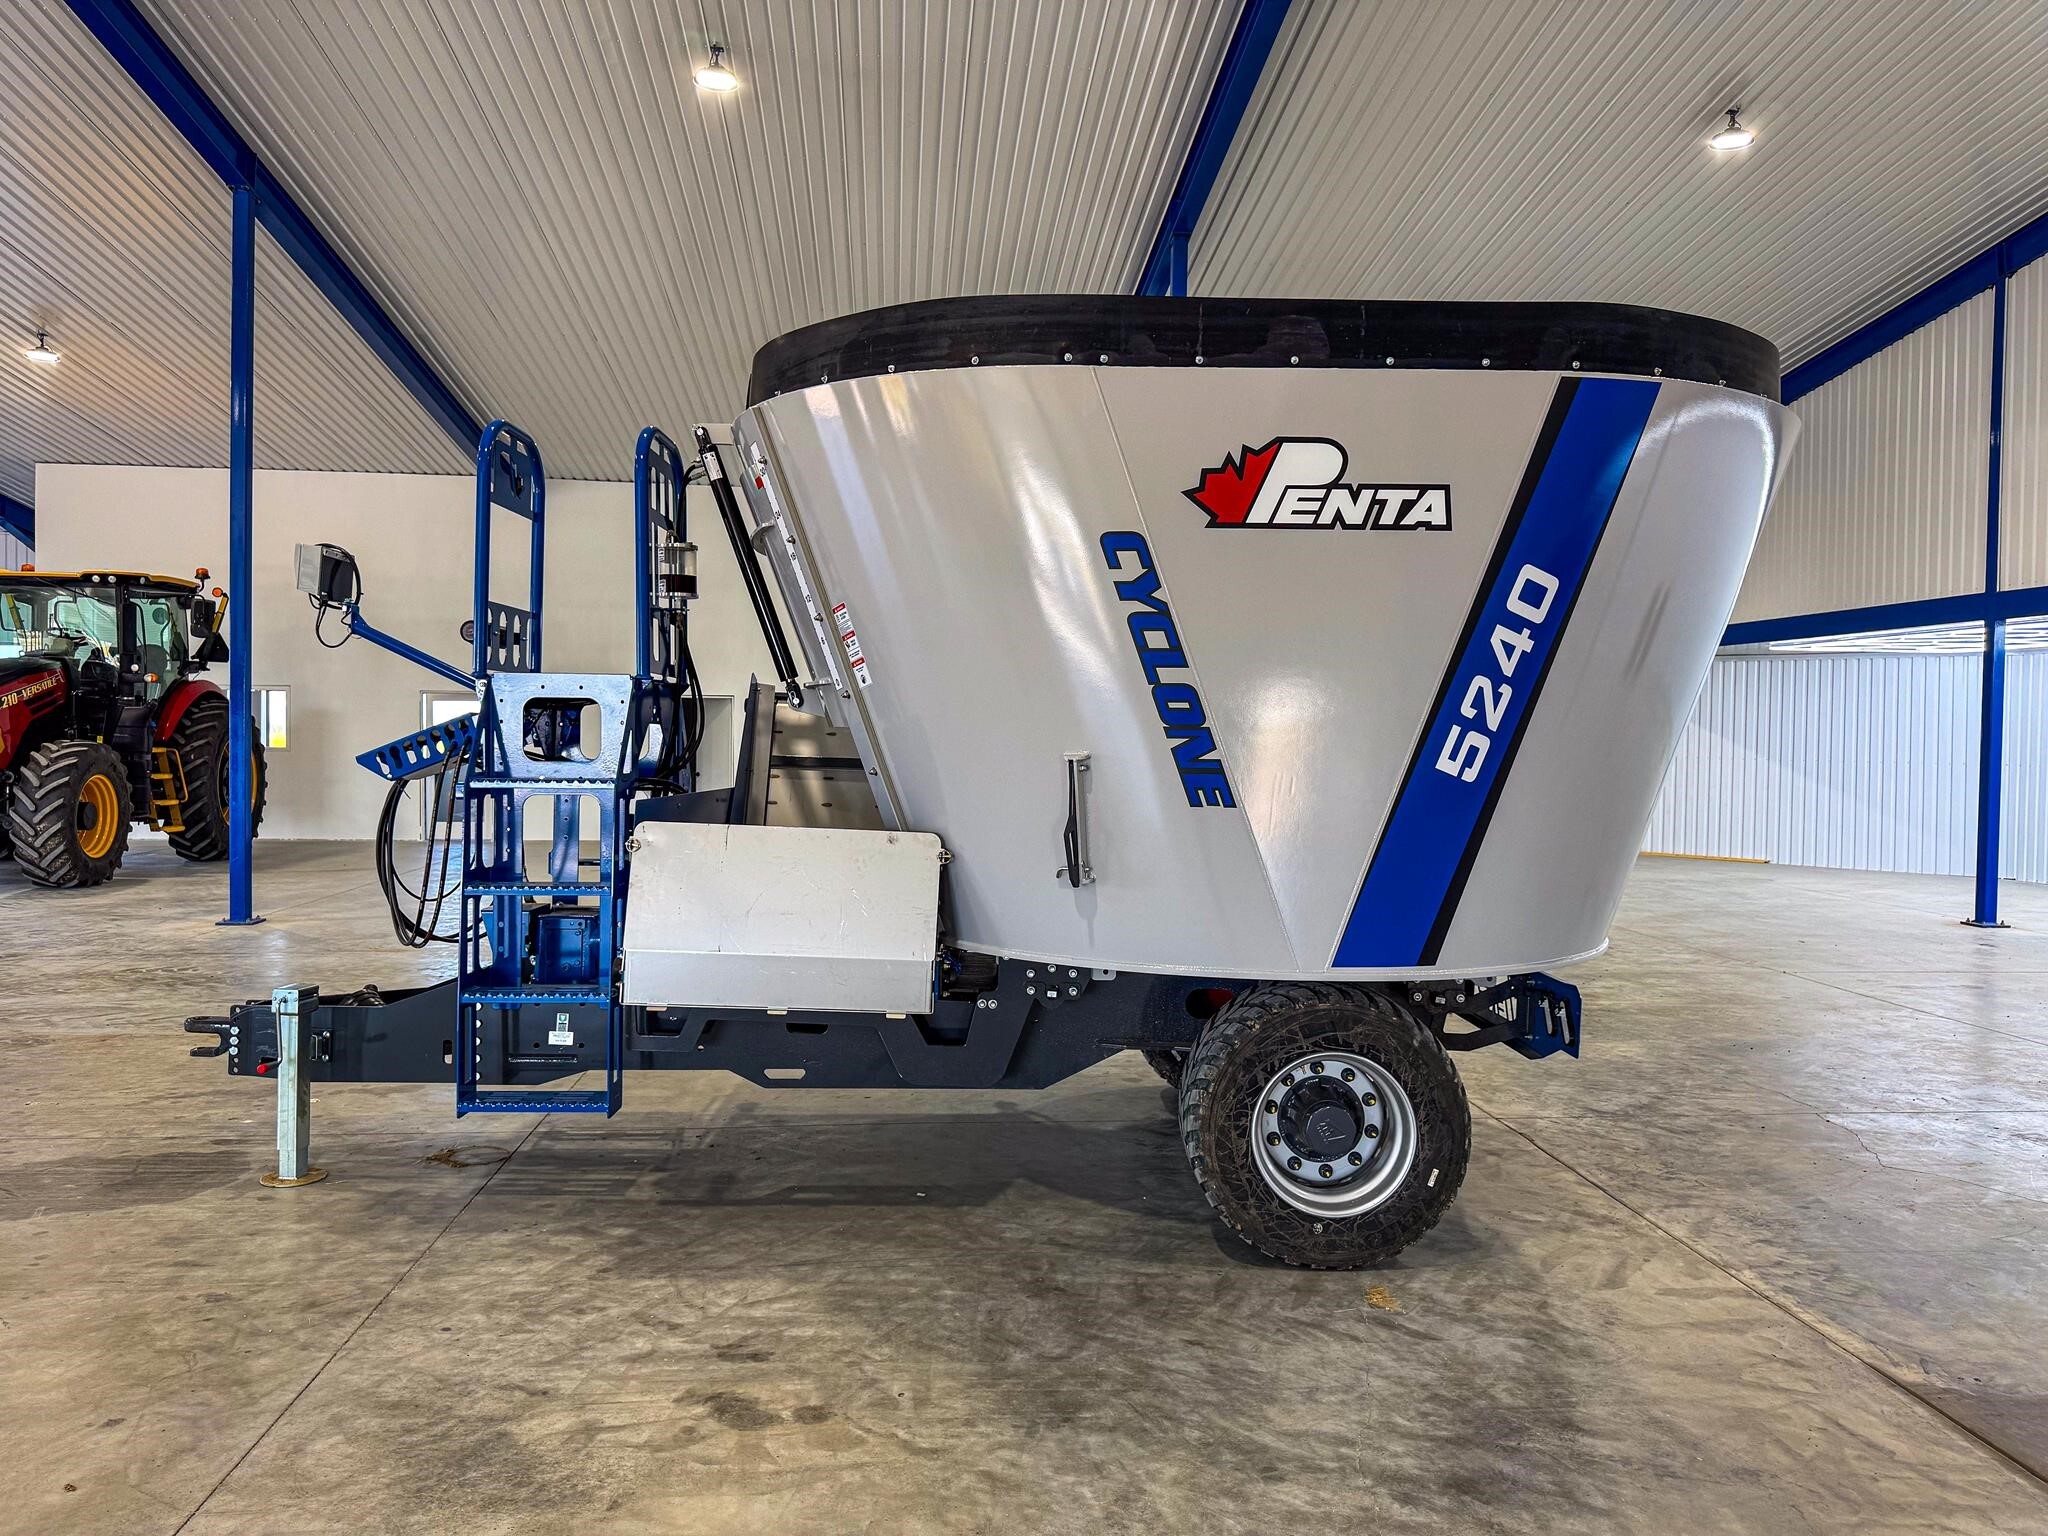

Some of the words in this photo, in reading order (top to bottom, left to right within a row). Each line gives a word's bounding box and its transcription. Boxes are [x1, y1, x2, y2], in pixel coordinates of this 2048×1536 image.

[1243, 438, 1451, 529] PENTA
[22, 678, 57, 698] VERSATILE
[1099, 530, 1237, 808] CYCLONE
[1435, 563, 1559, 783] 5240
